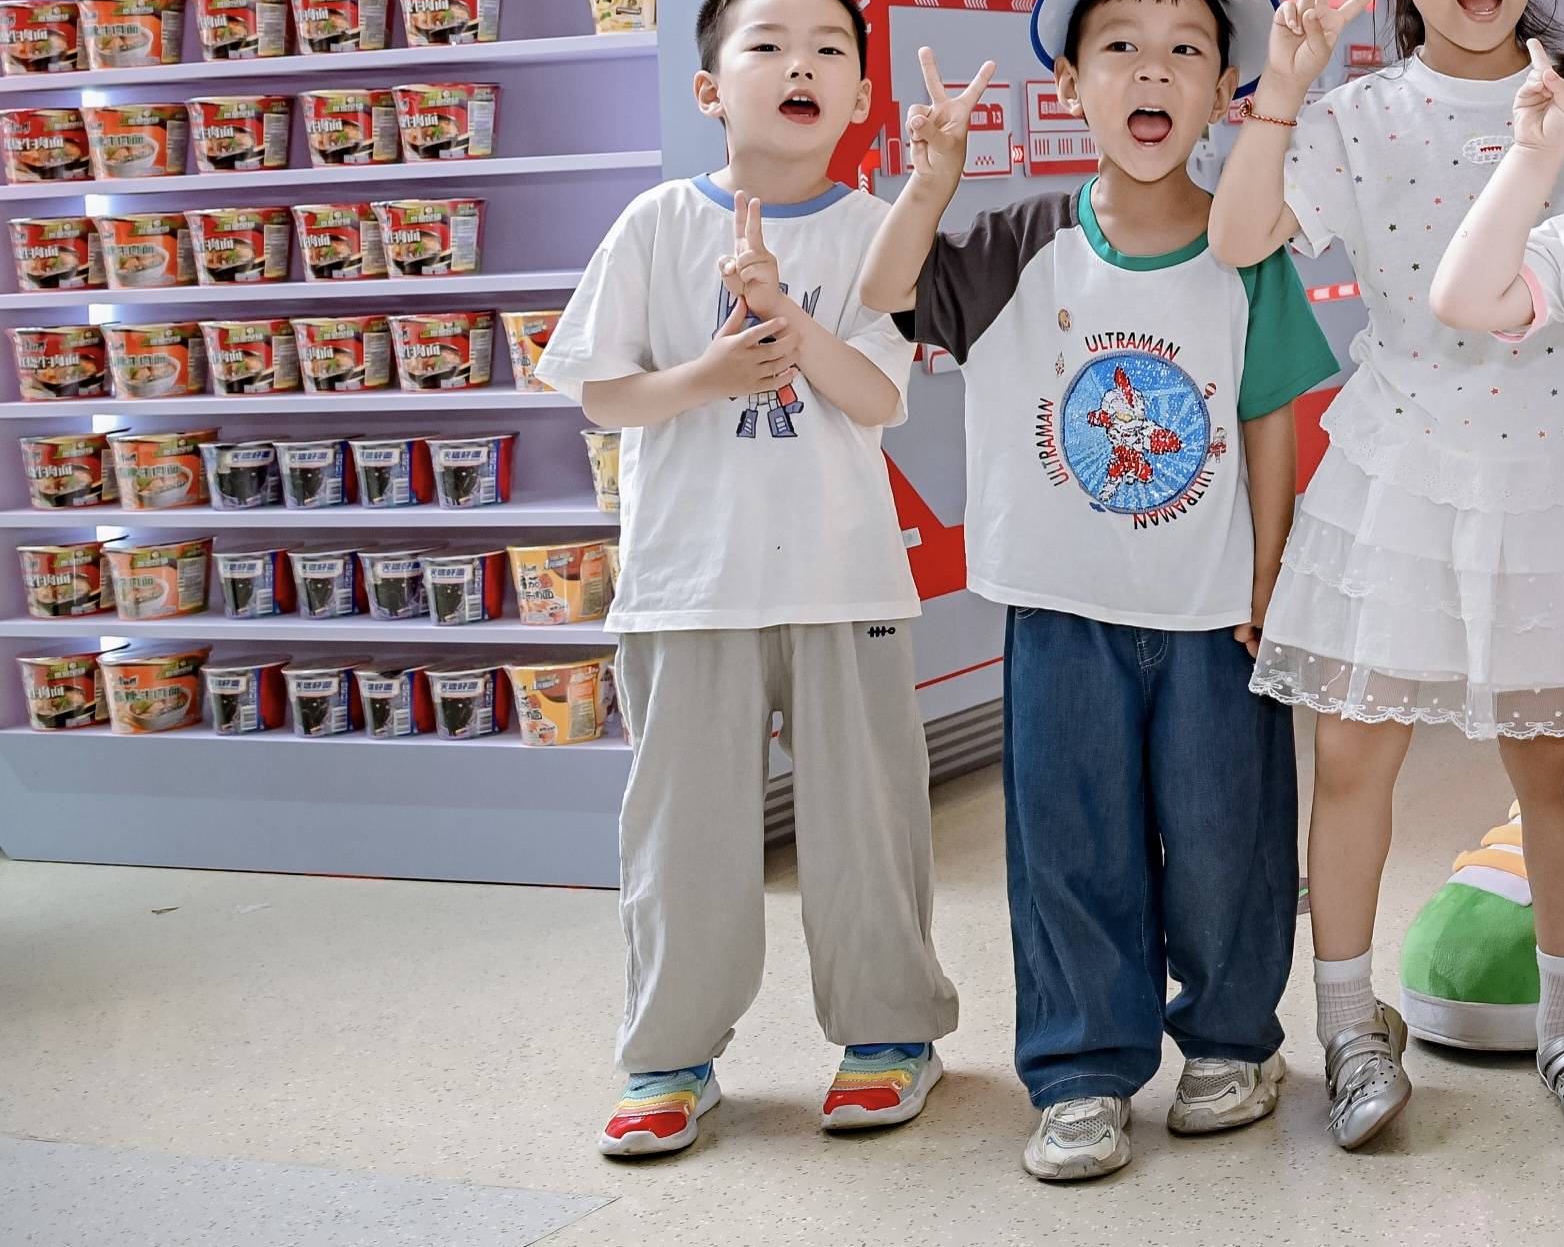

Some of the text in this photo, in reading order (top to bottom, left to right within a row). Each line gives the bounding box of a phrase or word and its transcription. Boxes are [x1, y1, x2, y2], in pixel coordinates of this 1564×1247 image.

[1085, 331, 1181, 362] ULTRAMAN
[1033, 397, 1070, 487] ULTRAMAN
[1133, 470, 1215, 530] ULTRAMAN
